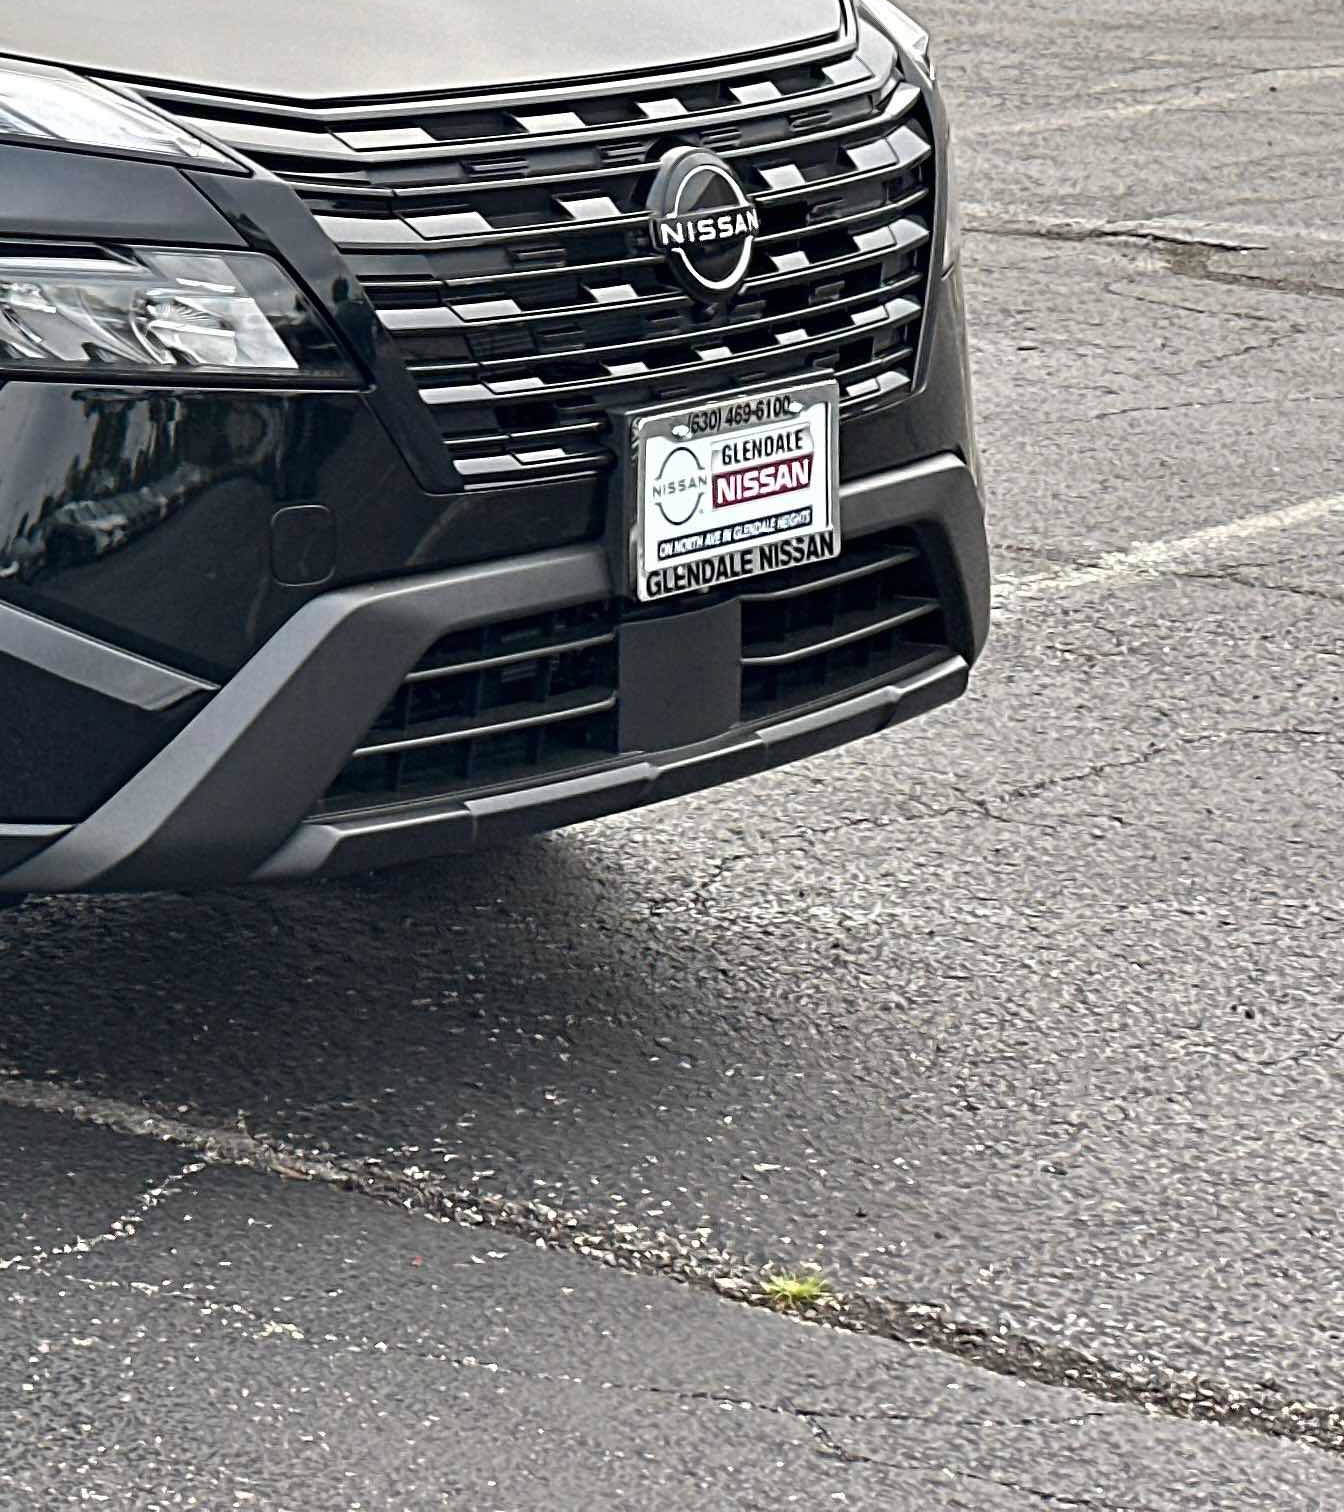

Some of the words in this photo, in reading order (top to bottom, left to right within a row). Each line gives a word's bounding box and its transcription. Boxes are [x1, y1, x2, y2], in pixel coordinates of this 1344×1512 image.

[660, 207, 760, 246] NISSAN
[688, 408, 721, 434] (630)
[725, 395, 792, 427] 469-6100
[722, 428, 805, 465] GLENDALE
[652, 473, 708, 498] NISSAN
[716, 458, 810, 505] NISSAN
[646, 549, 753, 597] GLENDALE
[758, 531, 835, 571] NISSAN
